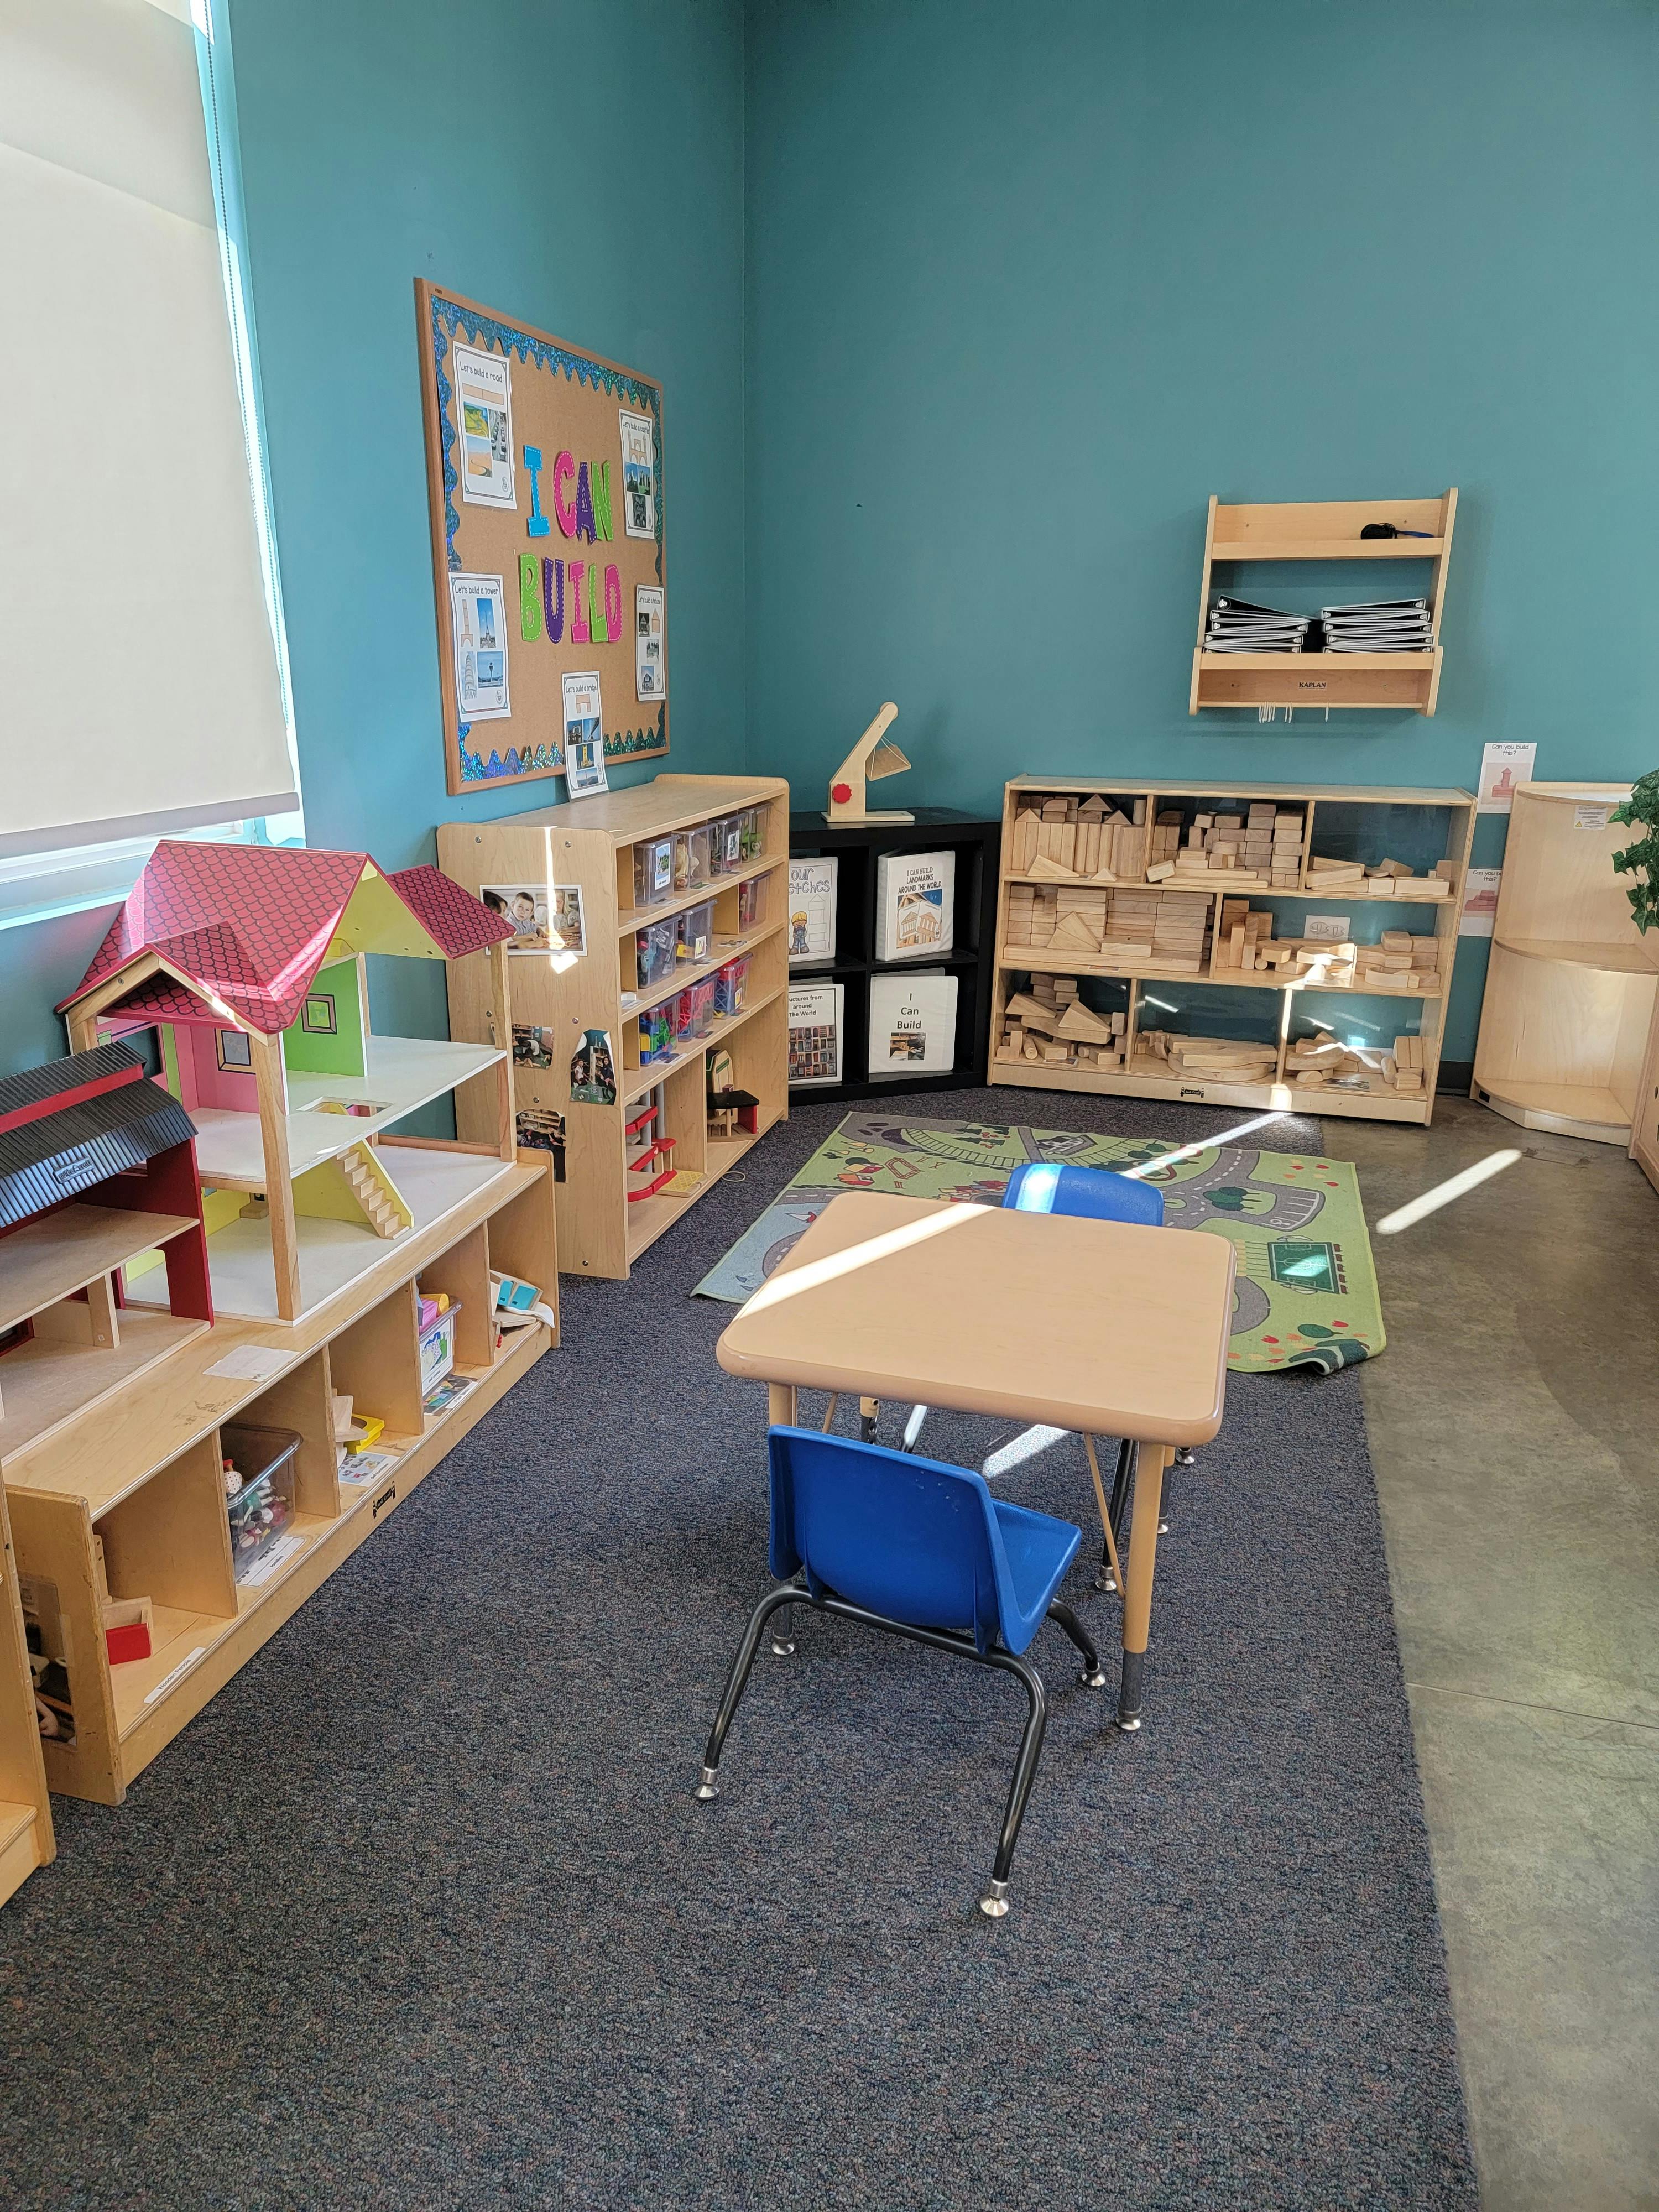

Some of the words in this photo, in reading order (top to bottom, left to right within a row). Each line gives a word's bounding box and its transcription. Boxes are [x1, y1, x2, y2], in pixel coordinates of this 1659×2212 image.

[460, 361, 473, 374] Let's
[474, 366, 484, 378] build
[490, 373, 503, 383] road
[523, 445, 551, 537] I
[554, 450, 614, 545] CAN
[455, 585, 468, 594] Let's
[468, 586, 479, 594] build
[485, 586, 498, 595] tower
[519, 552, 623, 644] BUILD
[587, 684, 597, 692] bridge
[791, 868, 814, 881] our
[906, 874, 934, 884] LANDMARKS
[898, 885, 917, 894] AROUND
[927, 881, 942, 889] WORLD
[910, 993, 912, 1001] I
[901, 1007, 919, 1015] Can
[897, 1020, 921, 1029] Build
[156, 1673, 177, 1690] Wooden
[174, 1659, 191, 1673] People
